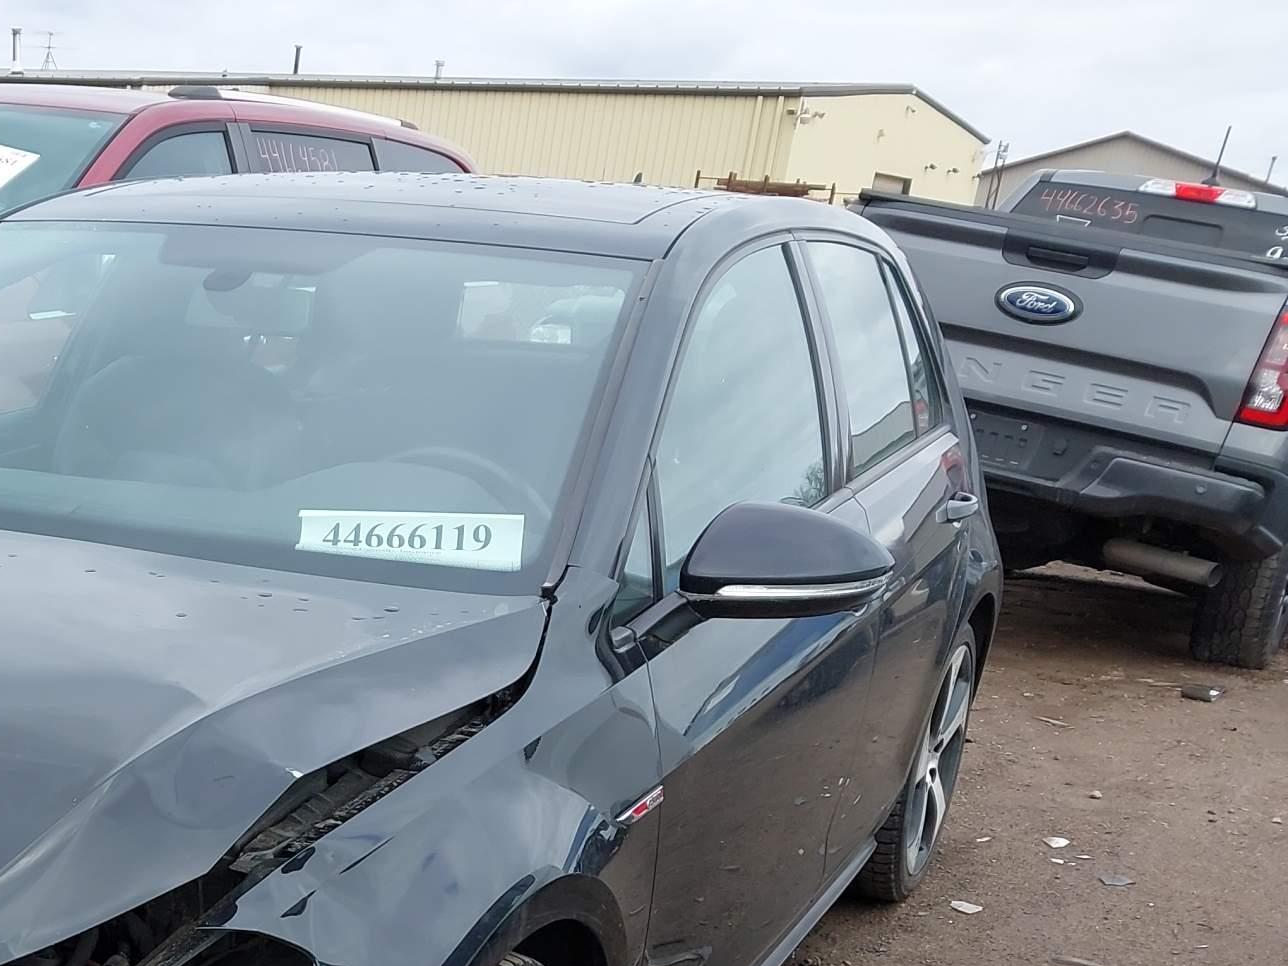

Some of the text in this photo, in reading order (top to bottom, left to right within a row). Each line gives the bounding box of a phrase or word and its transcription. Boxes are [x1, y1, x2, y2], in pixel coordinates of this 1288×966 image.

[1040, 188, 1140, 224] 44662635
[1016, 291, 1058, 313] Ford
[959, 356, 1192, 425] NGER
[322, 522, 492, 551] 44666119
